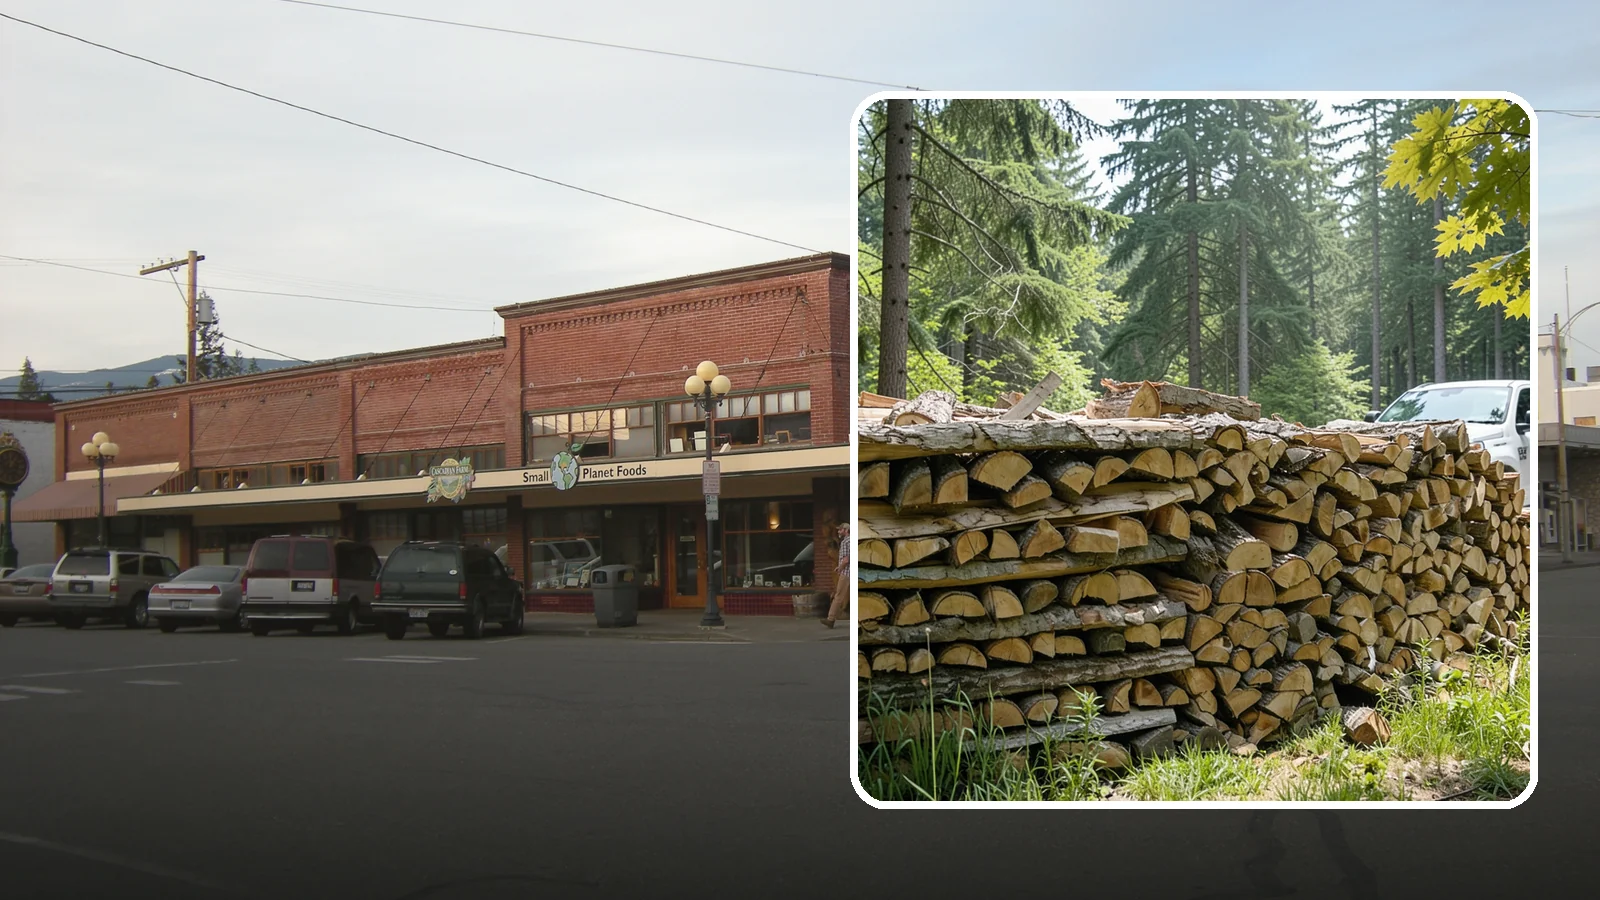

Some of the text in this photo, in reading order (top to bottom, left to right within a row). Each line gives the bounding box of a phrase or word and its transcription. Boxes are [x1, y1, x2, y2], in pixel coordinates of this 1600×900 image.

[523, 464, 647, 483] Small Planet Foods
